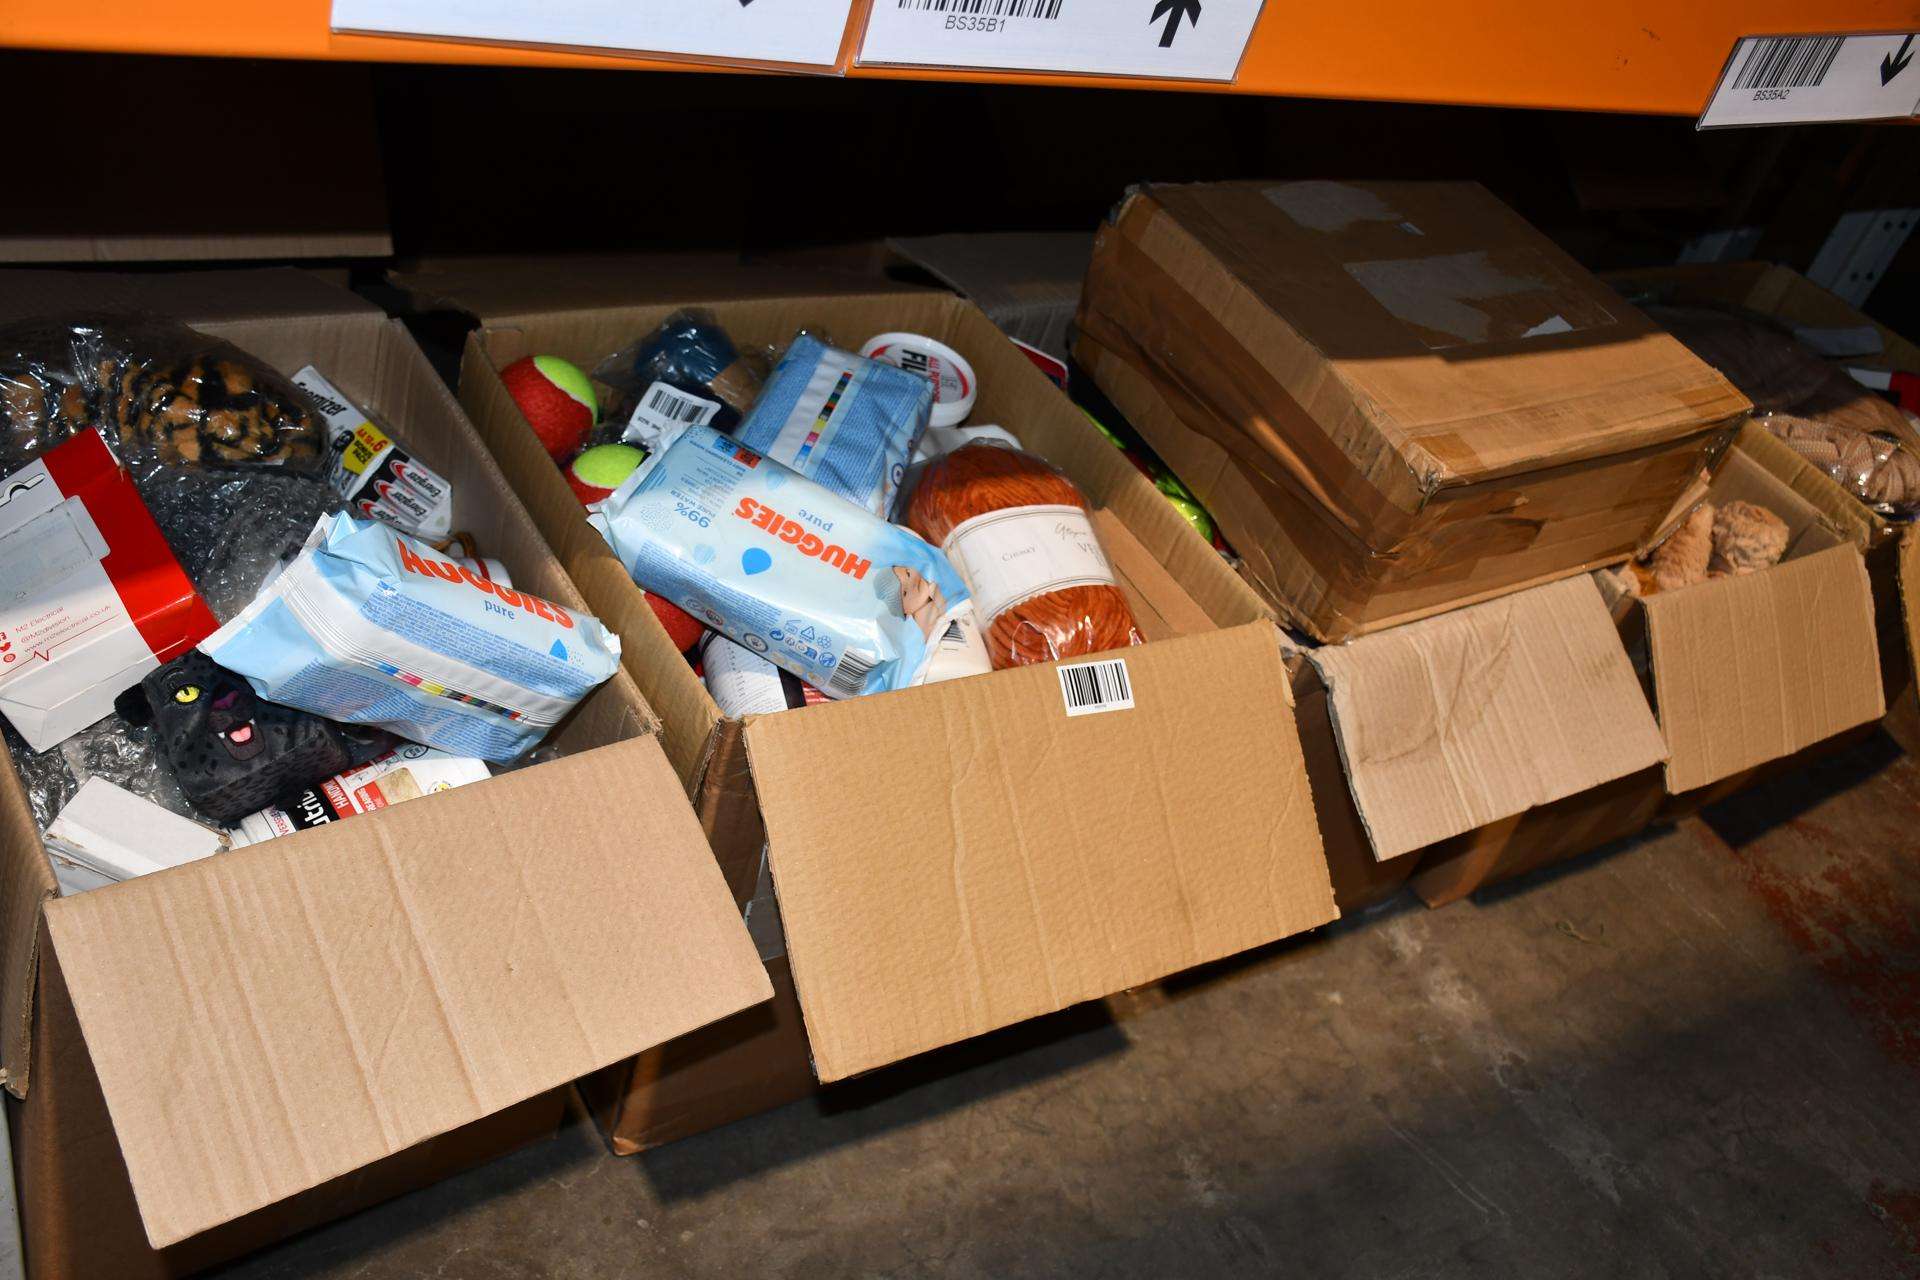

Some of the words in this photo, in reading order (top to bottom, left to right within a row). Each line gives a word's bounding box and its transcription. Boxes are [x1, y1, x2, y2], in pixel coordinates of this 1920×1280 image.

[944, 15, 1006, 32] BS35B1
[1752, 89, 1790, 101] BS35A2
[673, 501, 713, 529] 99%
[797, 509, 836, 533] pure
[735, 496, 872, 580] HUGGIES
[396, 536, 574, 629] HUGGIES
[484, 599, 515, 620] pure
